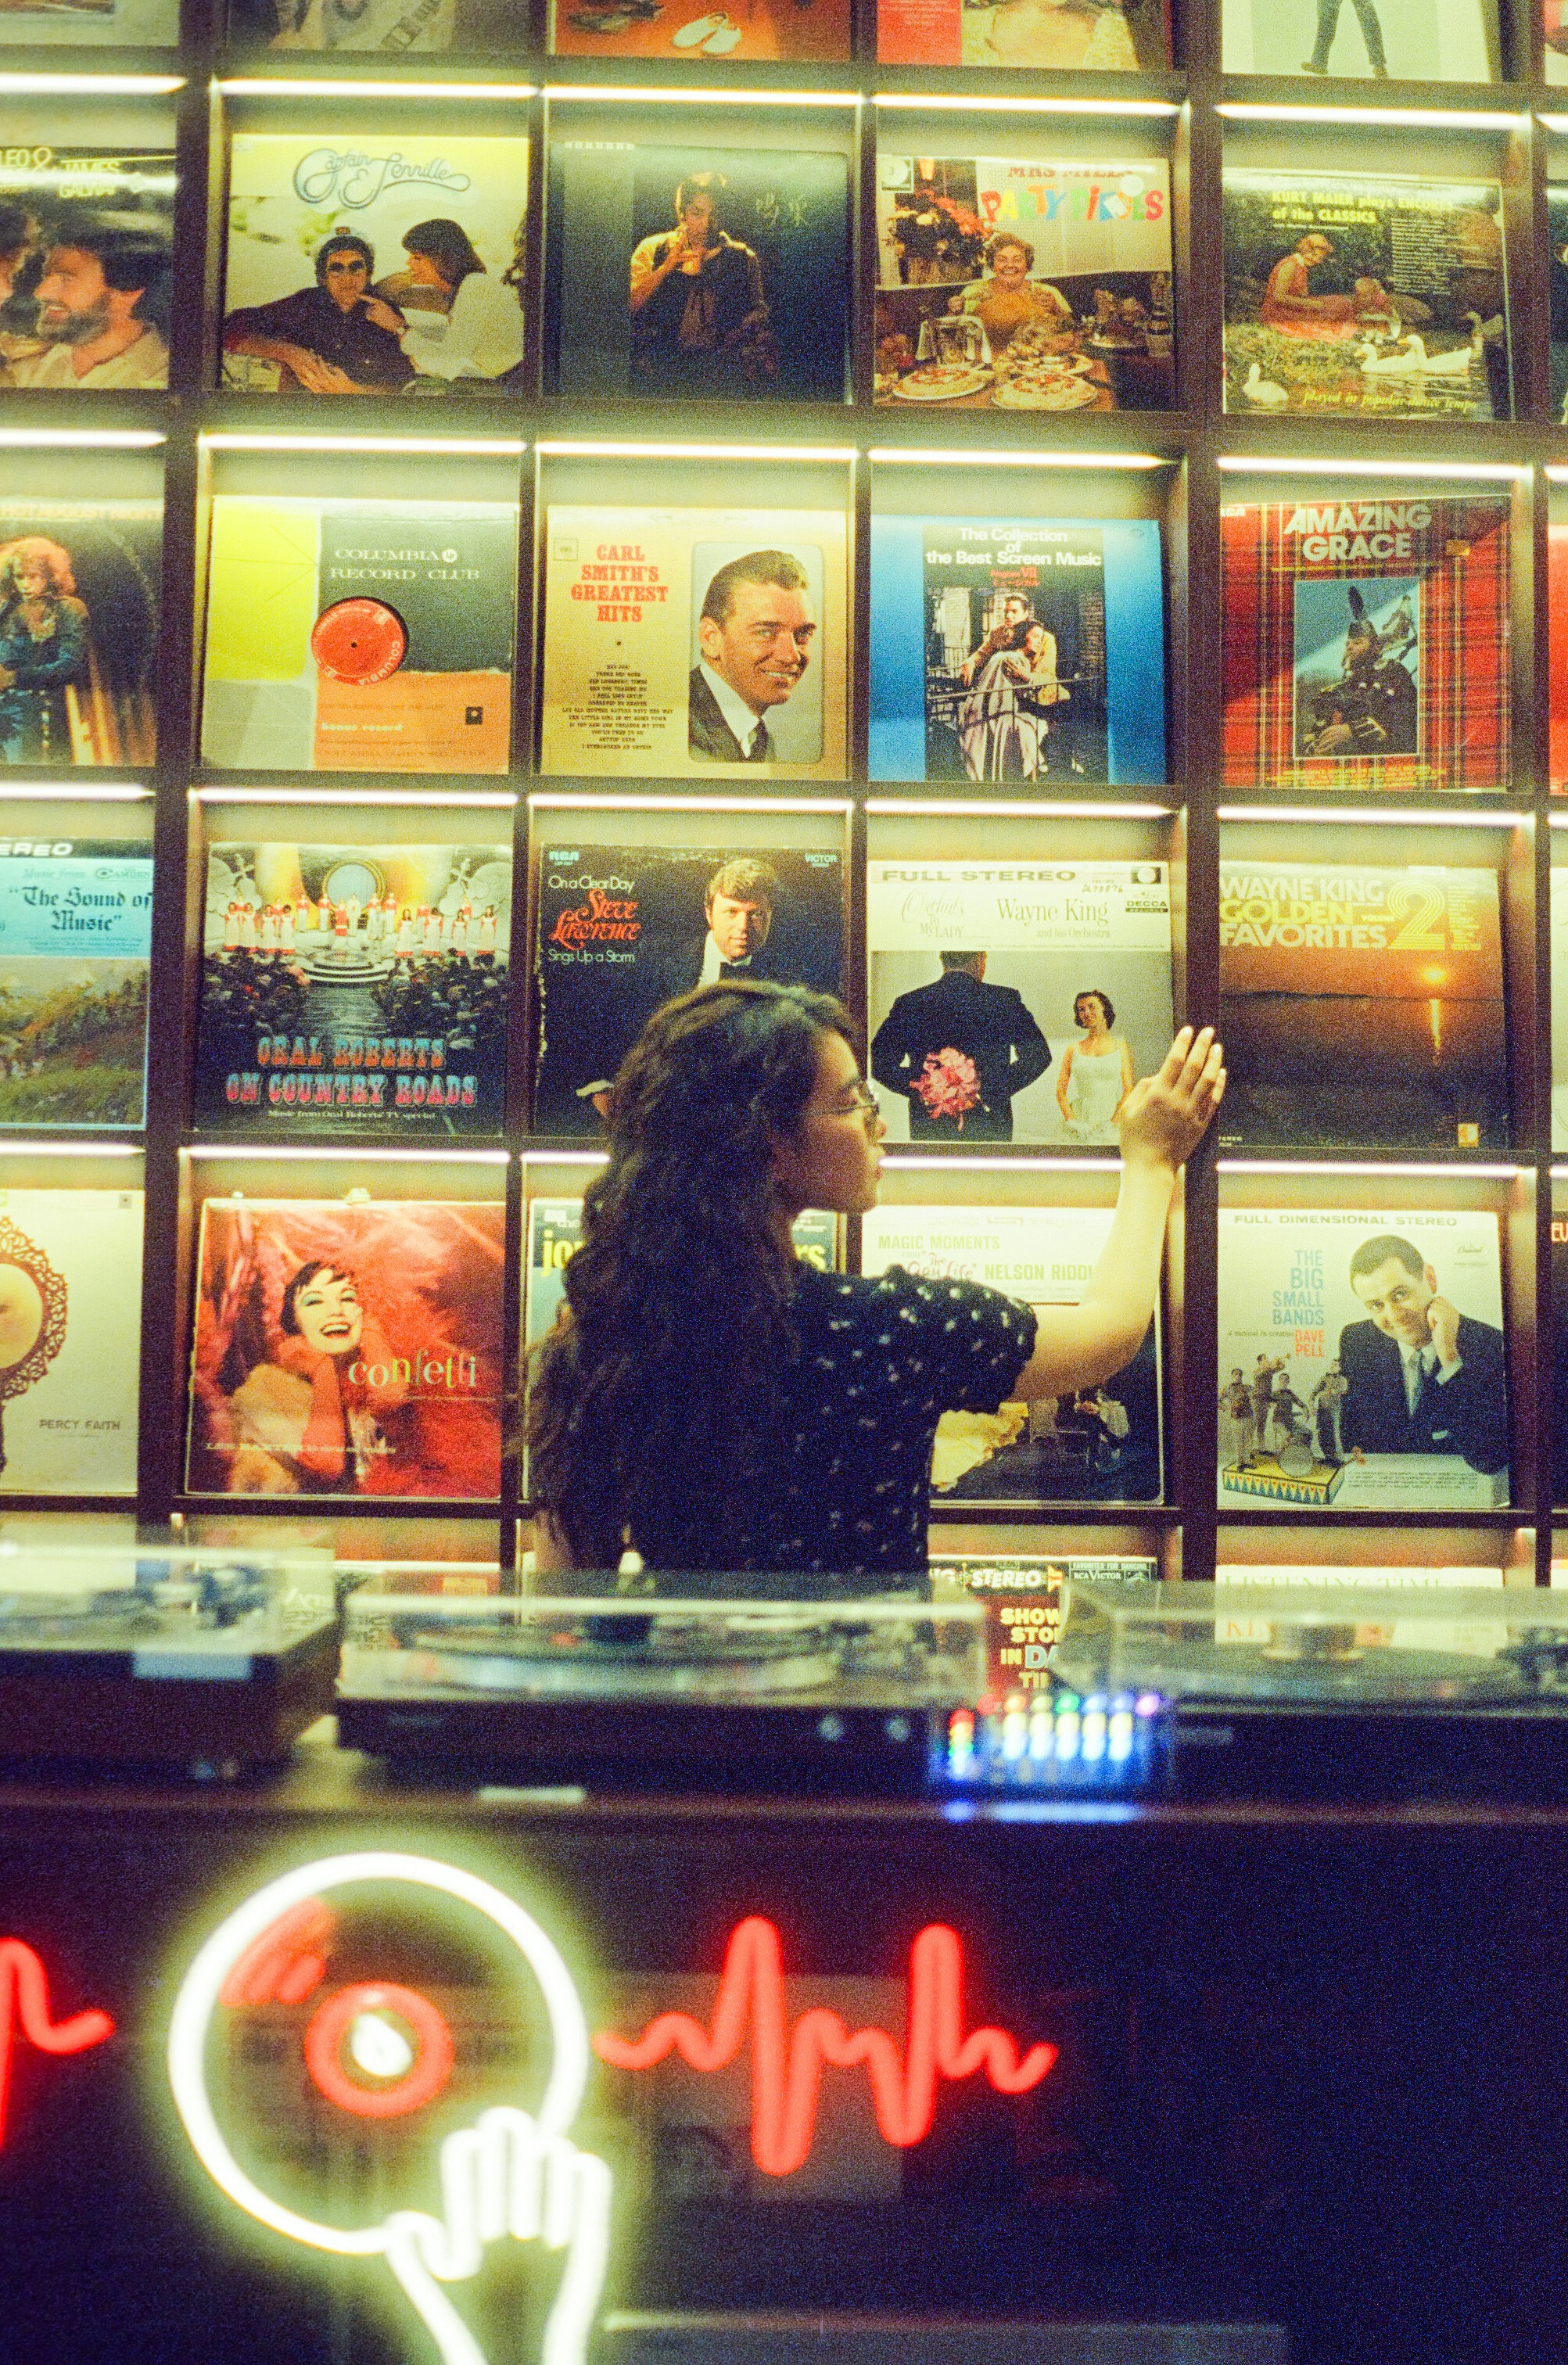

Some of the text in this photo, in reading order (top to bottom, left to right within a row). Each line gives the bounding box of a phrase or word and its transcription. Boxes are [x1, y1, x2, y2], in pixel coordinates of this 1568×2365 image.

[0, 149, 29, 167] EO
[980, 184, 1067, 223] PARTY
[1272, 207, 1377, 224] of the CLASSICS
[1283, 504, 1433, 535] AMAZING
[959, 527, 1068, 543] The Collection
[335, 548, 440, 562] COLUMBIA
[596, 544, 645, 562] CARL
[1004, 540, 1022, 554] of
[1301, 533, 1411, 562] GRACE
[925, 550, 1103, 566] the Best Screen Music
[331, 567, 481, 581] RECORD CLUB
[580, 565, 659, 583] SMITH'S
[570, 585, 669, 603] GREATEST
[595, 605, 643, 623] HITS
[804, 852, 838, 863] VICTOR
[547, 874, 635, 894] On a Clear Day
[882, 870, 1077, 881] FULL STEREO
[63, 886, 127, 907] Sound
[1219, 875, 1384, 903] WAYNE KING
[996, 898, 1110, 927] Wayne King
[1219, 899, 1353, 925] GOLDEN
[1386, 881, 1446, 950] 2
[1219, 922, 1387, 949] FAVORITES
[576, 949, 594, 966] Up
[595, 953, 605, 963] a
[257, 1035, 323, 1067] ORAL
[268, 1073, 389, 1107] COUNTRY
[395, 1075, 479, 1107] ROADS
[1233, 1215, 1459, 1227] FULL DIMENSIONAL STEREO
[877, 1235, 1000, 1251] MAGIC MOMENTS
[1294, 1249, 1324, 1266] THE
[984, 1263, 1045, 1281] NELSON
[1289, 1268, 1324, 1290] BIG
[1272, 1290, 1324, 1308] SMALL
[1272, 1308, 1325, 1326] BANDS
[1294, 1329, 1326, 1344] DAVE
[1294, 1344, 1326, 1358] PELL
[348, 1351, 478, 1388] confetti
[39, 1418, 121, 1432] PERCY FAITH
[971, 1569, 1042, 1588] STEREO
[1073, 1569, 1121, 1581] RCA VICTOR
[1000, 1649, 1023, 1665] IN
